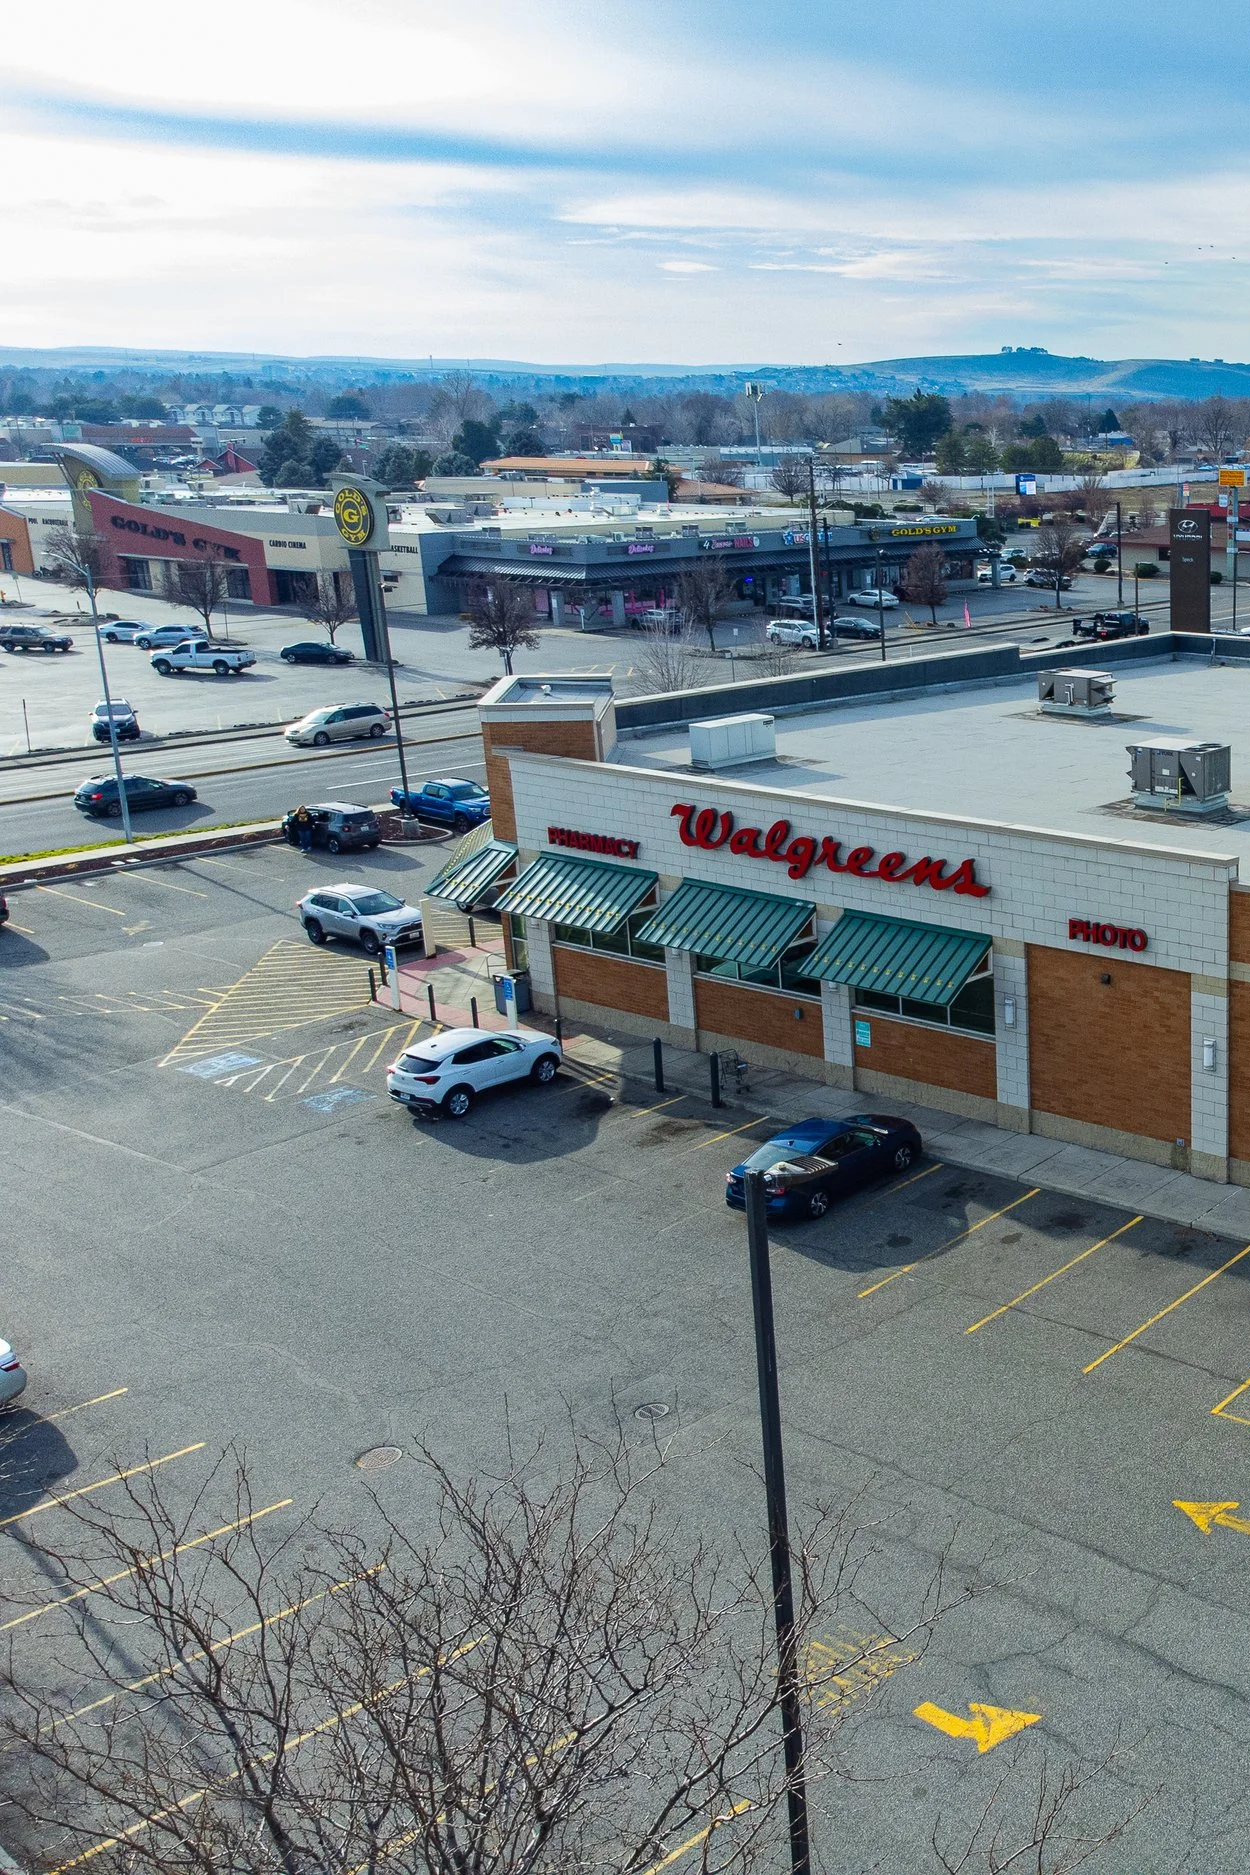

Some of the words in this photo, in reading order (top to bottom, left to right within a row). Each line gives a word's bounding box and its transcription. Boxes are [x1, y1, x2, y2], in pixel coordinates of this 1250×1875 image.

[335, 490, 367, 516] GOLD'S
[343, 508, 360, 523] G
[341, 528, 366, 541] GYM
[891, 527, 932, 537] GOLD'S
[932, 525, 957, 534] GYM
[269, 540, 287, 549] CARDIO
[288, 541, 307, 549] CINEMA
[391, 545, 419, 554] ASKETBALL
[547, 826, 641, 859] PHARMACY
[670, 803, 992, 898] Walgreens
[1068, 917, 1149, 952] PHOTO
